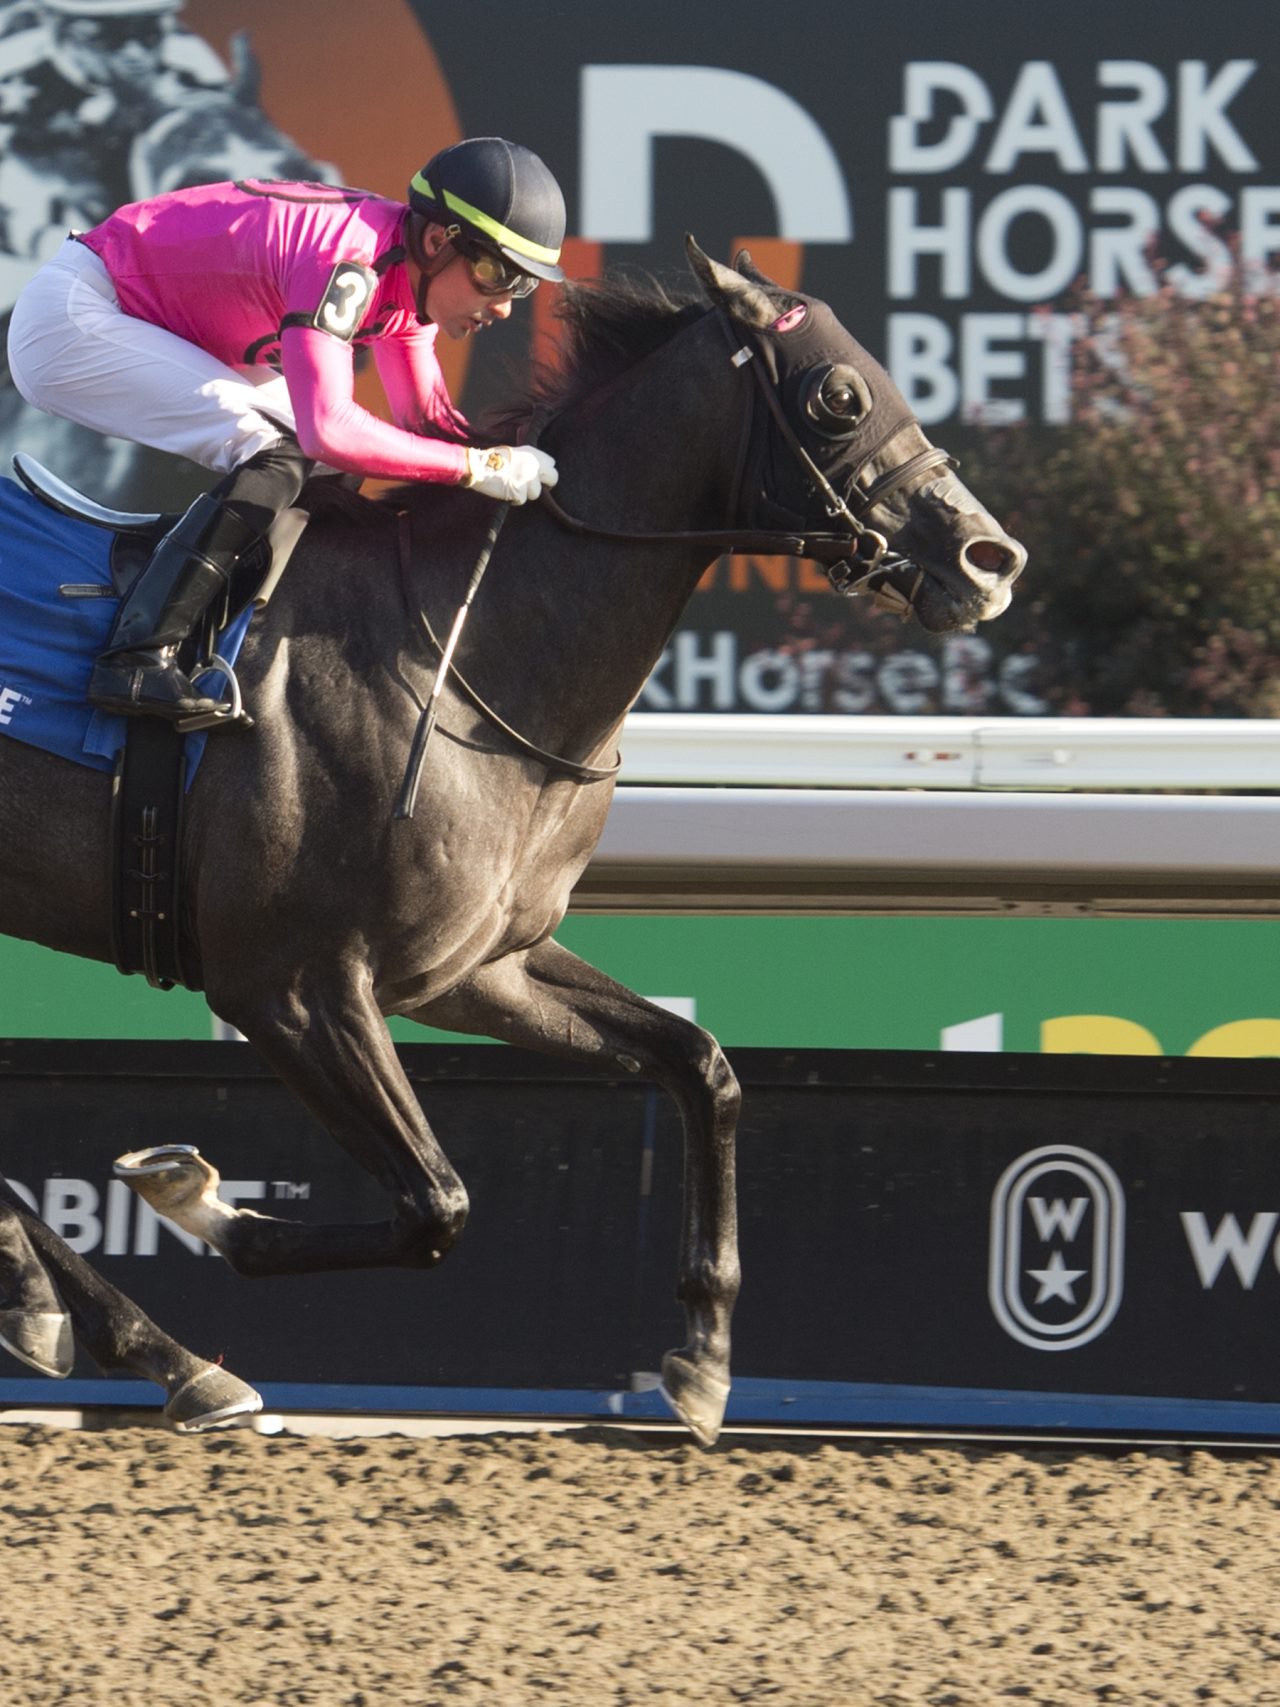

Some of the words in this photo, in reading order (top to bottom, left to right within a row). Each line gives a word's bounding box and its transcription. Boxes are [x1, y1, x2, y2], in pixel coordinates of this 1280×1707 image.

[888, 60, 1261, 174] DARK
[324, 271, 368, 331] 3
[1027, 1197, 1089, 1242] W
[1179, 1211, 1280, 1290] W
